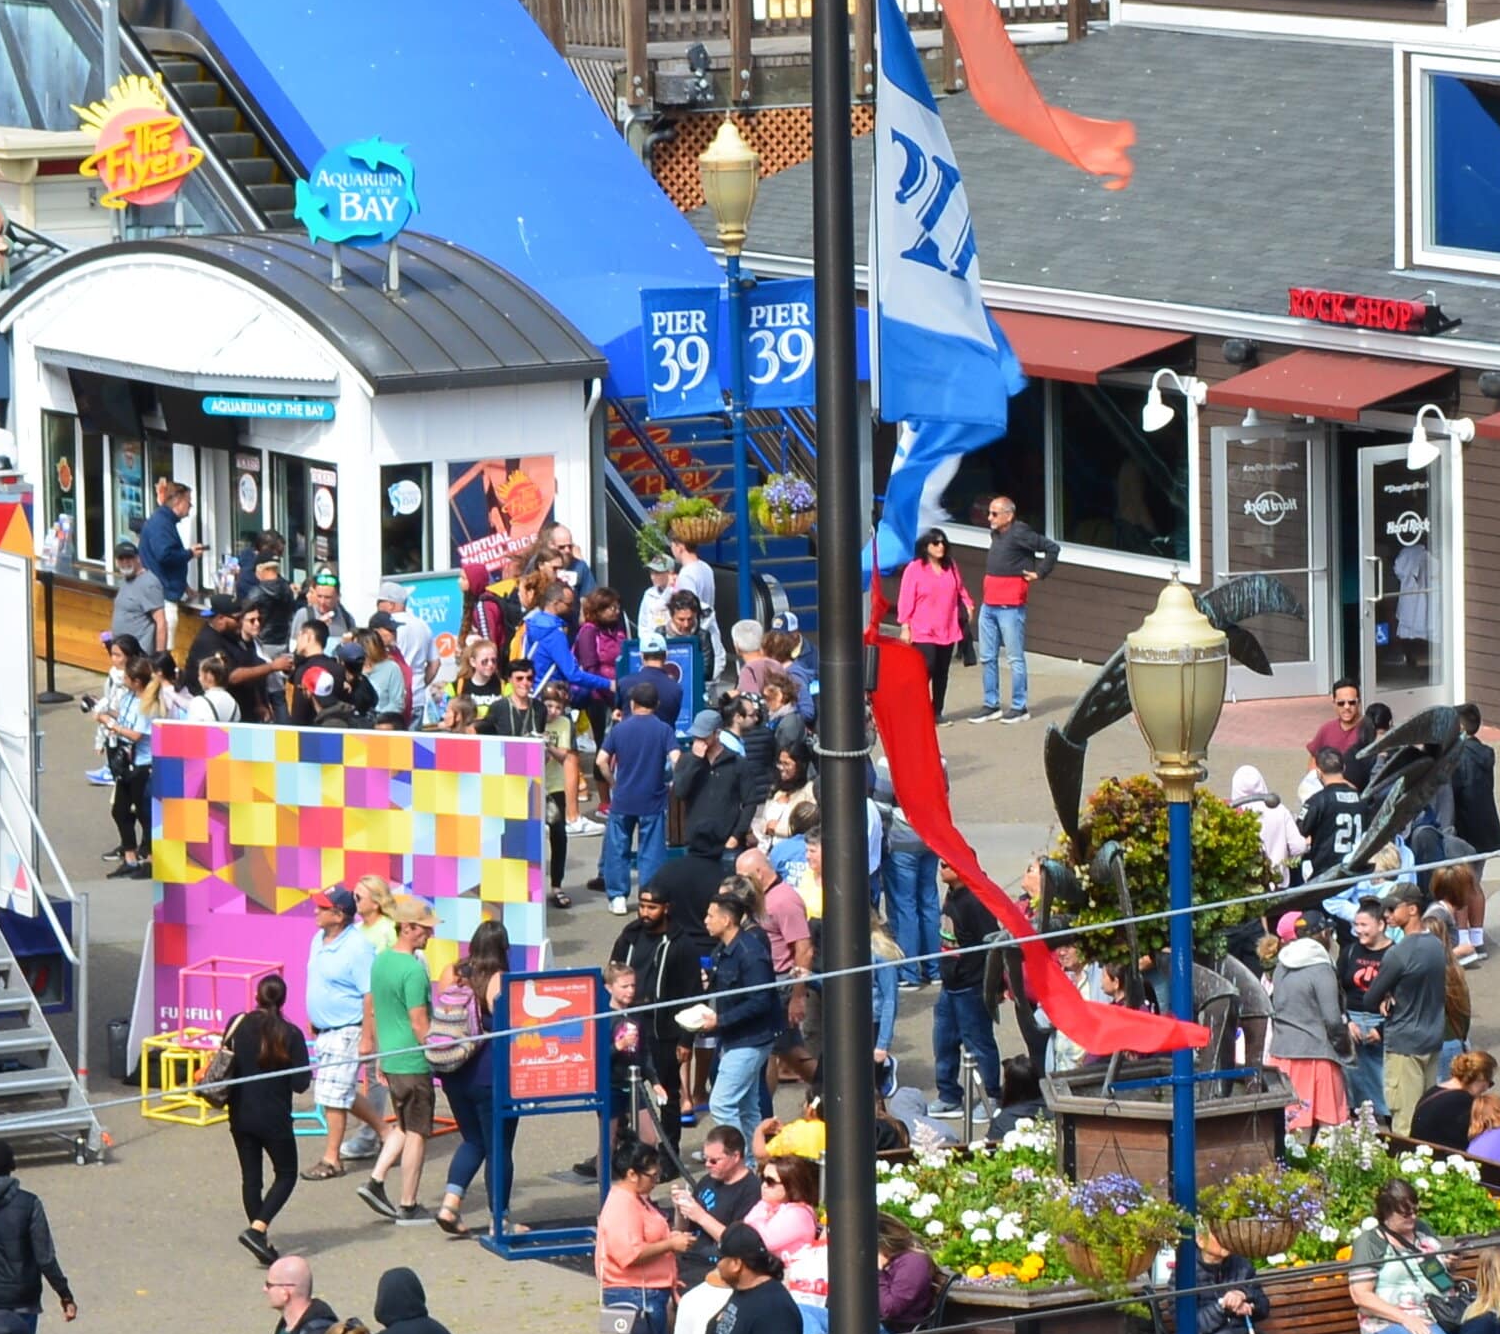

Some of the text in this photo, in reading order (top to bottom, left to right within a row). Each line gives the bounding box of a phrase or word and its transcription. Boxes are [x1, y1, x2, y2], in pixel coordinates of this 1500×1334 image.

[124, 117, 182, 157] The
[316, 168, 403, 191] AQUARIUM
[338, 192, 400, 222] BAY
[651, 309, 708, 336] PIER
[749, 302, 811, 328] PIER
[1287, 287, 1414, 332] ROCK SHOP
[652, 335, 710, 393] 39
[748, 327, 815, 385] 39
[211, 401, 326, 418] AQUARIUM OF THE BAY
[1386, 517, 1431, 534] Hard Rock
[458, 531, 511, 558] VIRTUAL
[1334, 813, 1363, 855] 21
